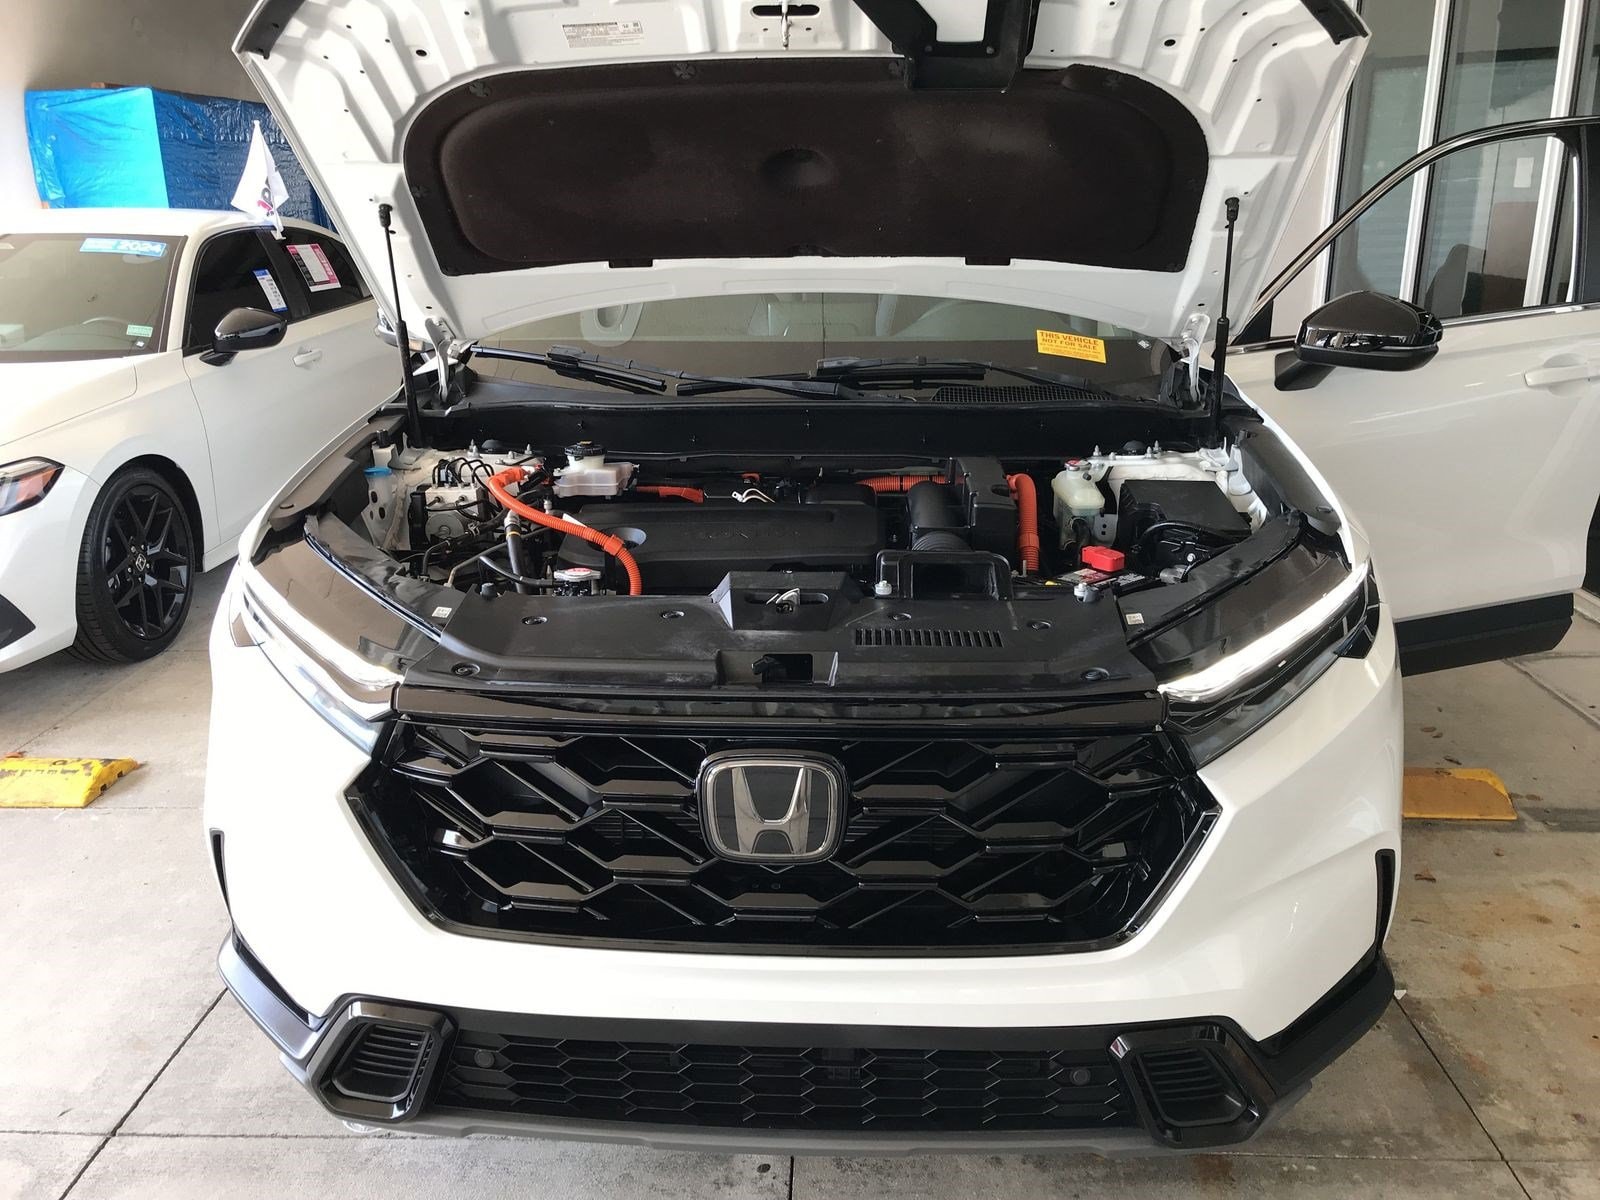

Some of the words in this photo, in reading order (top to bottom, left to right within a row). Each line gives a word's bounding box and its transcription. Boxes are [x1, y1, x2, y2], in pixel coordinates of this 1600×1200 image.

[117, 240, 162, 253] 2024
[1040, 331, 1060, 340] THIS
[1062, 334, 1099, 346] VEHICLE
[1078, 343, 1098, 351] SALE
